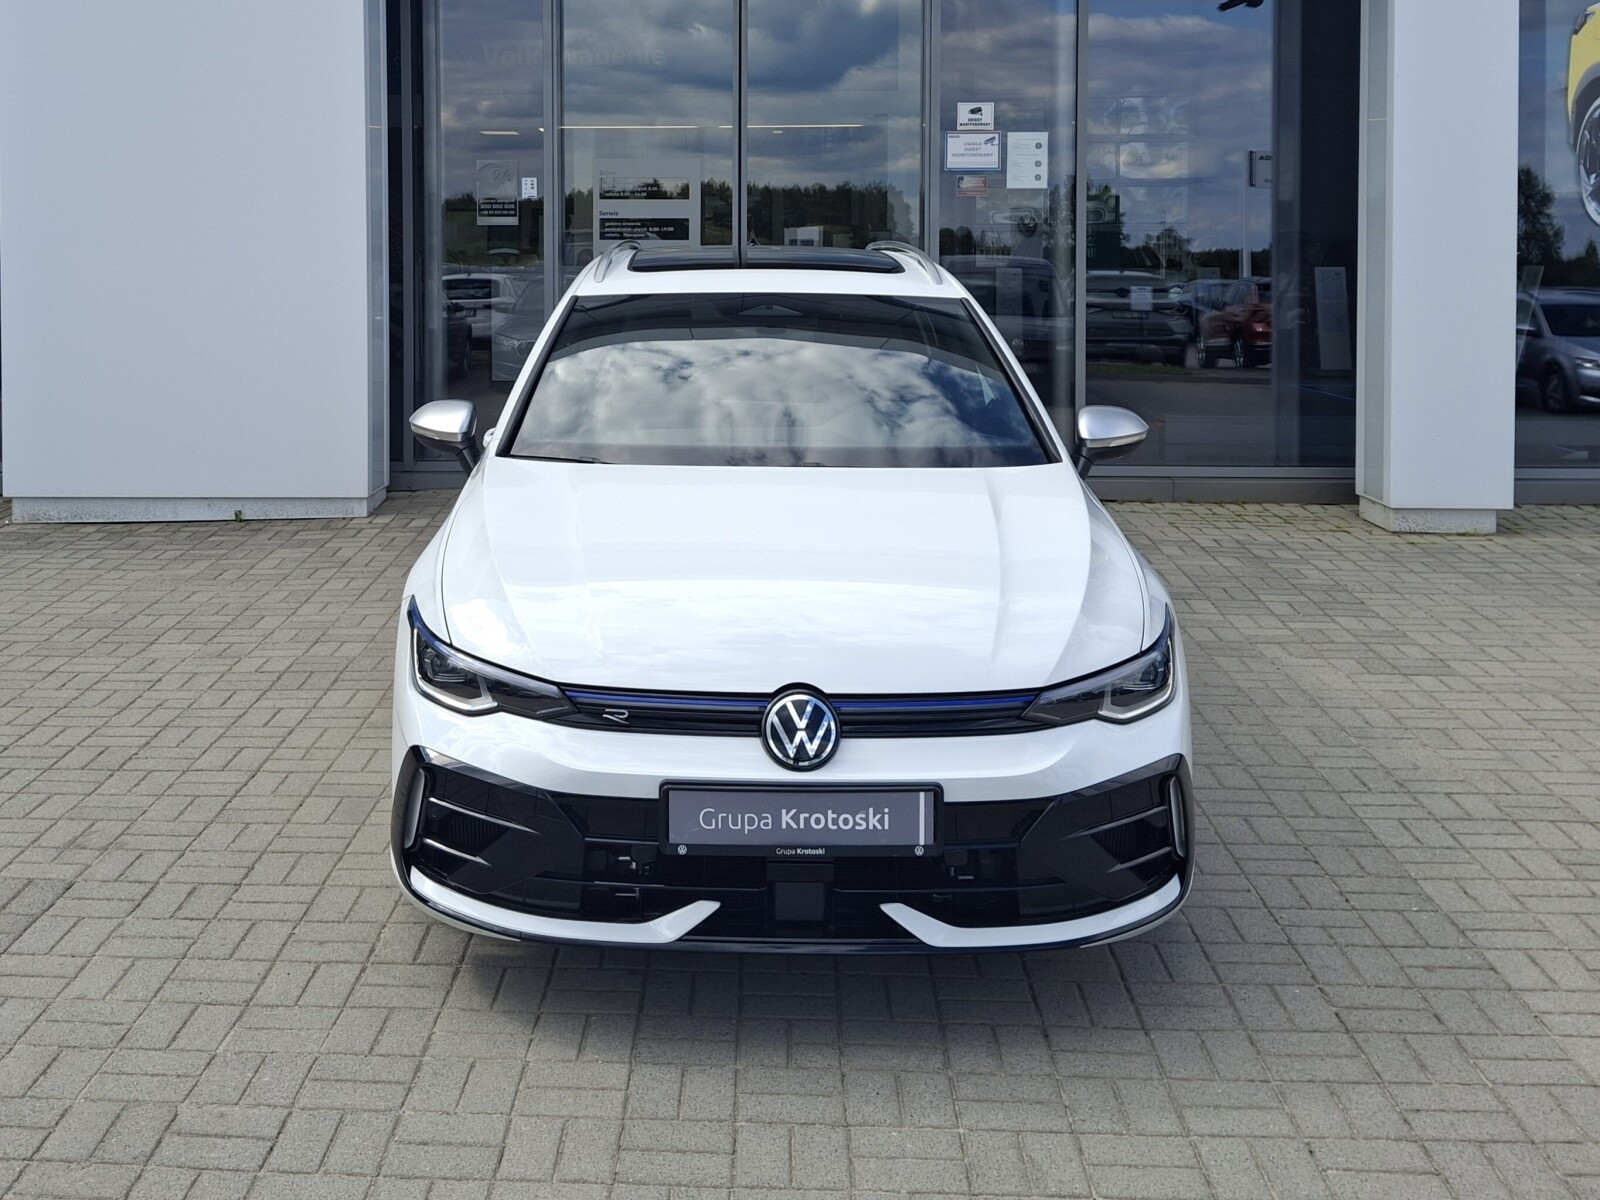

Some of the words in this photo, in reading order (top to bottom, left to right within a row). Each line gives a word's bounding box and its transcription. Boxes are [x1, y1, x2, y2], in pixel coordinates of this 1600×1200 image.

[699, 808, 772, 835] Grupa
[781, 807, 890, 830] Krotoski
[776, 848, 796, 856] Grupa
[796, 847, 825, 855] Krotoski
